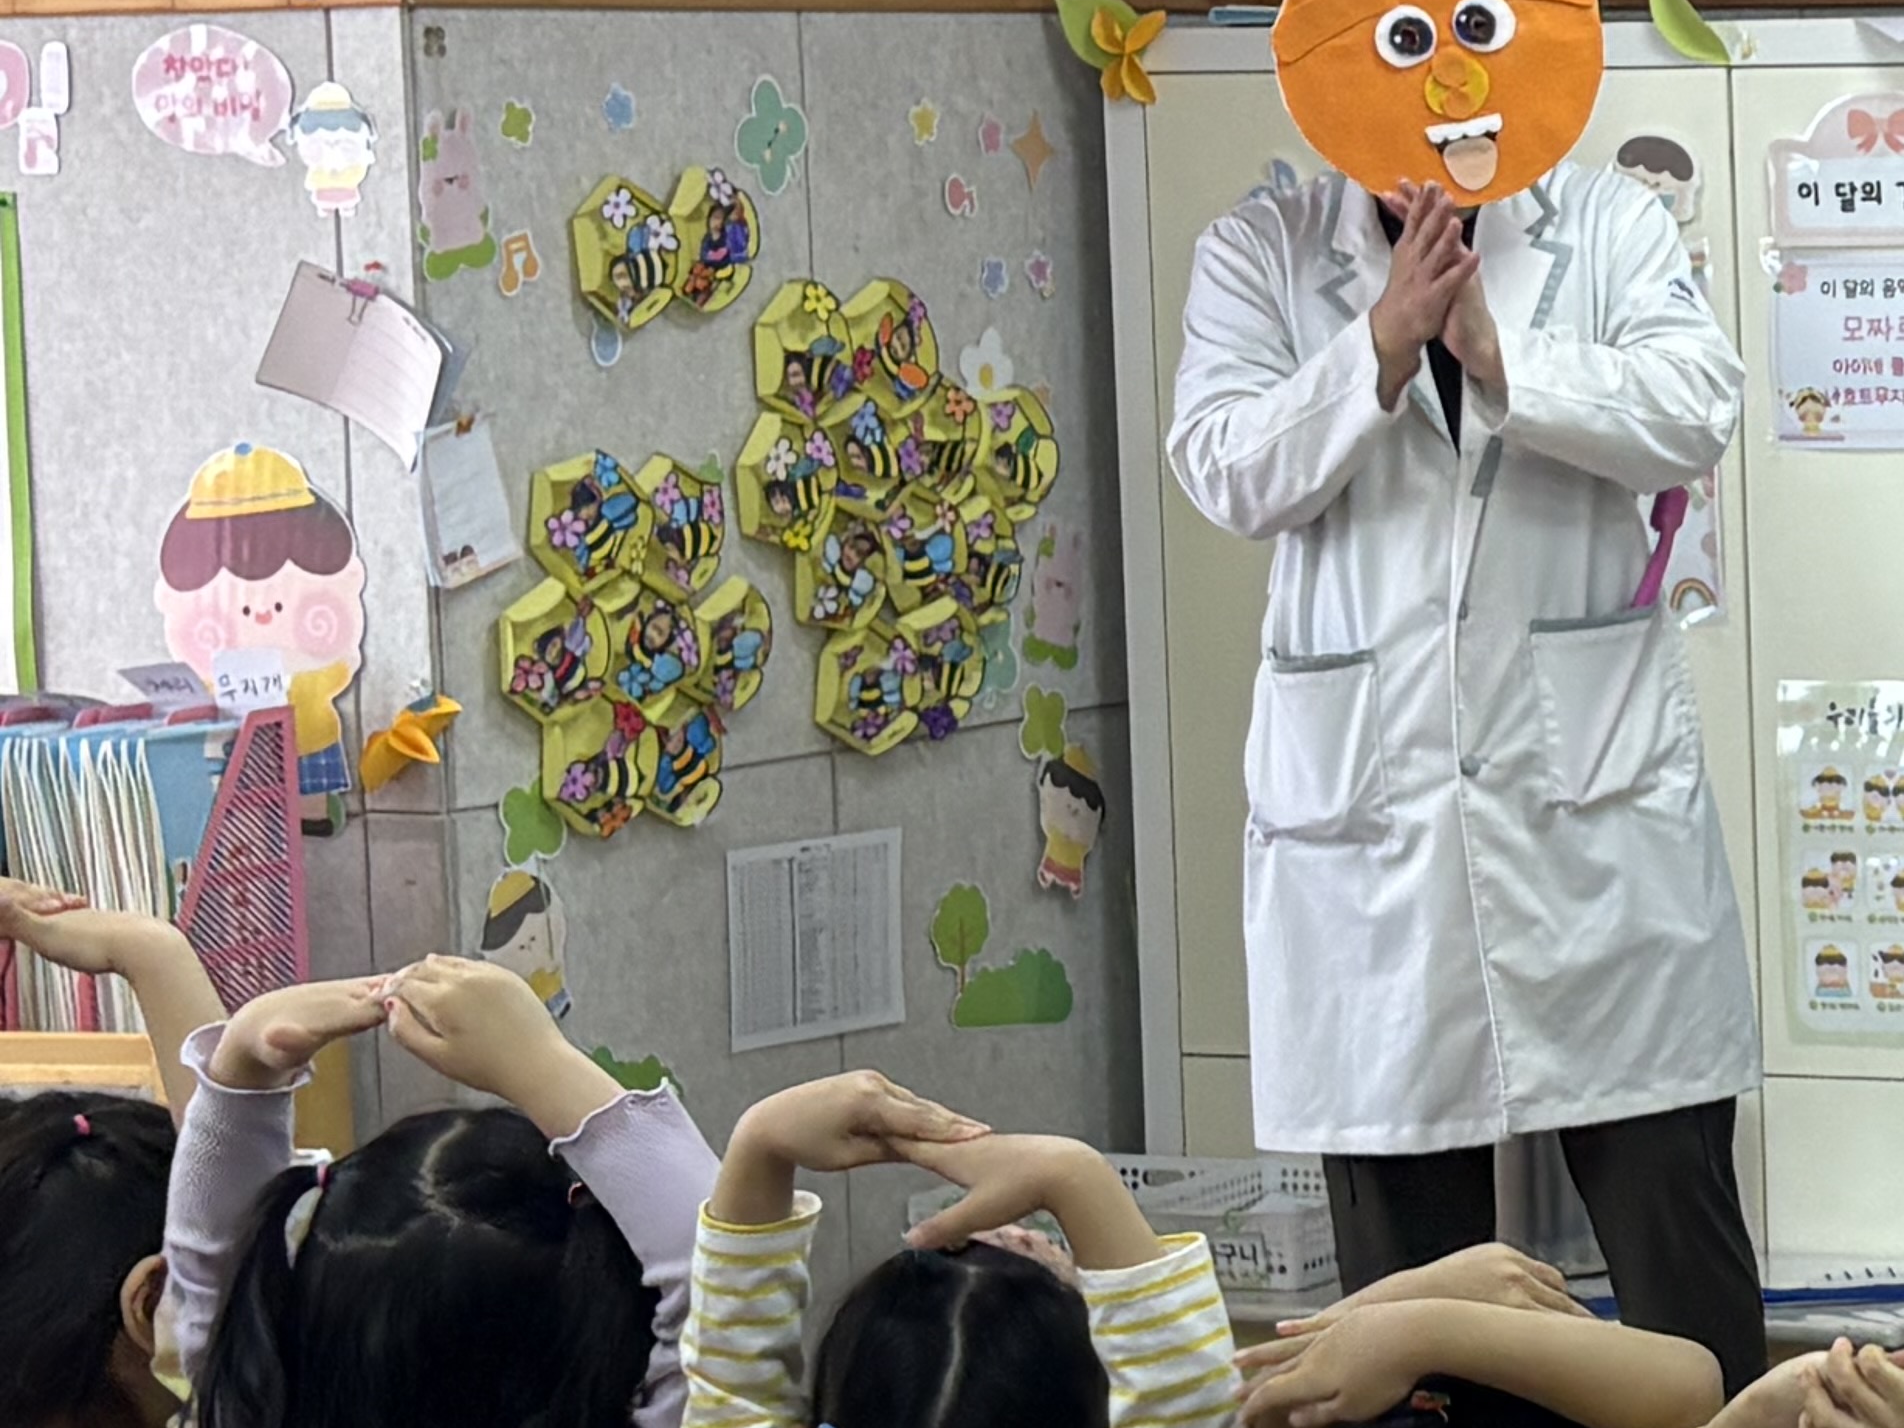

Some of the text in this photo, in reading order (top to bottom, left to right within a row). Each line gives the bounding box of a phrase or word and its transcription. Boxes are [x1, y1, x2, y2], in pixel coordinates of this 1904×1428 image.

[1797, 181, 1821, 207] 이
[1834, 180, 1884, 213] 달의
[1820, 279, 1837, 298] 이
[1844, 278, 1876, 298] 달의
[1832, 357, 1884, 375] 아이네
